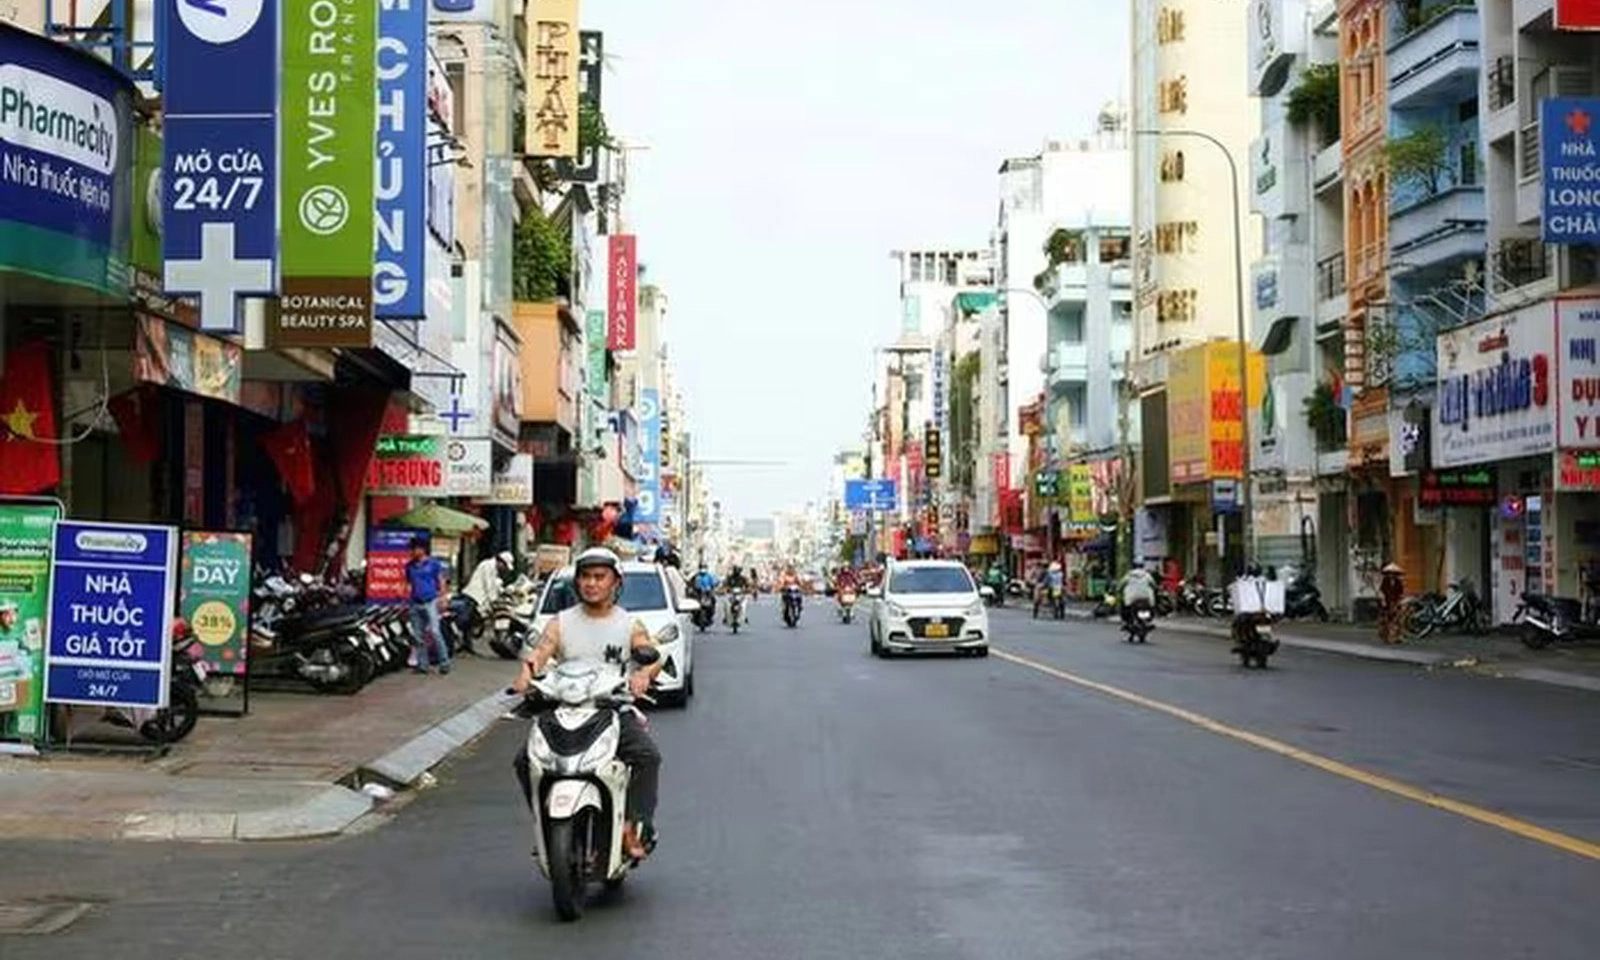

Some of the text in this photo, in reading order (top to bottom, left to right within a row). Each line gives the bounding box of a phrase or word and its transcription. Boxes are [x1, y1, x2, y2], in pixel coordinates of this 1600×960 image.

[535, 21, 570, 149] PHÁT
[307, 71, 336, 171] YVES
[174, 147, 263, 173] MỞ CỬA
[173, 177, 264, 210] 24/7
[1549, 212, 1600, 234] CHÂ
[280, 295, 366, 309] BOTANICAL
[280, 314, 366, 328] BEAUTY SPA
[1533, 351, 1549, 407] 3
[193, 565, 239, 585] DAY
[70, 597, 143, 626] THUỐC
[65, 629, 146, 657] GIÁ TỐT
[88, 682, 119, 697] 24/7
